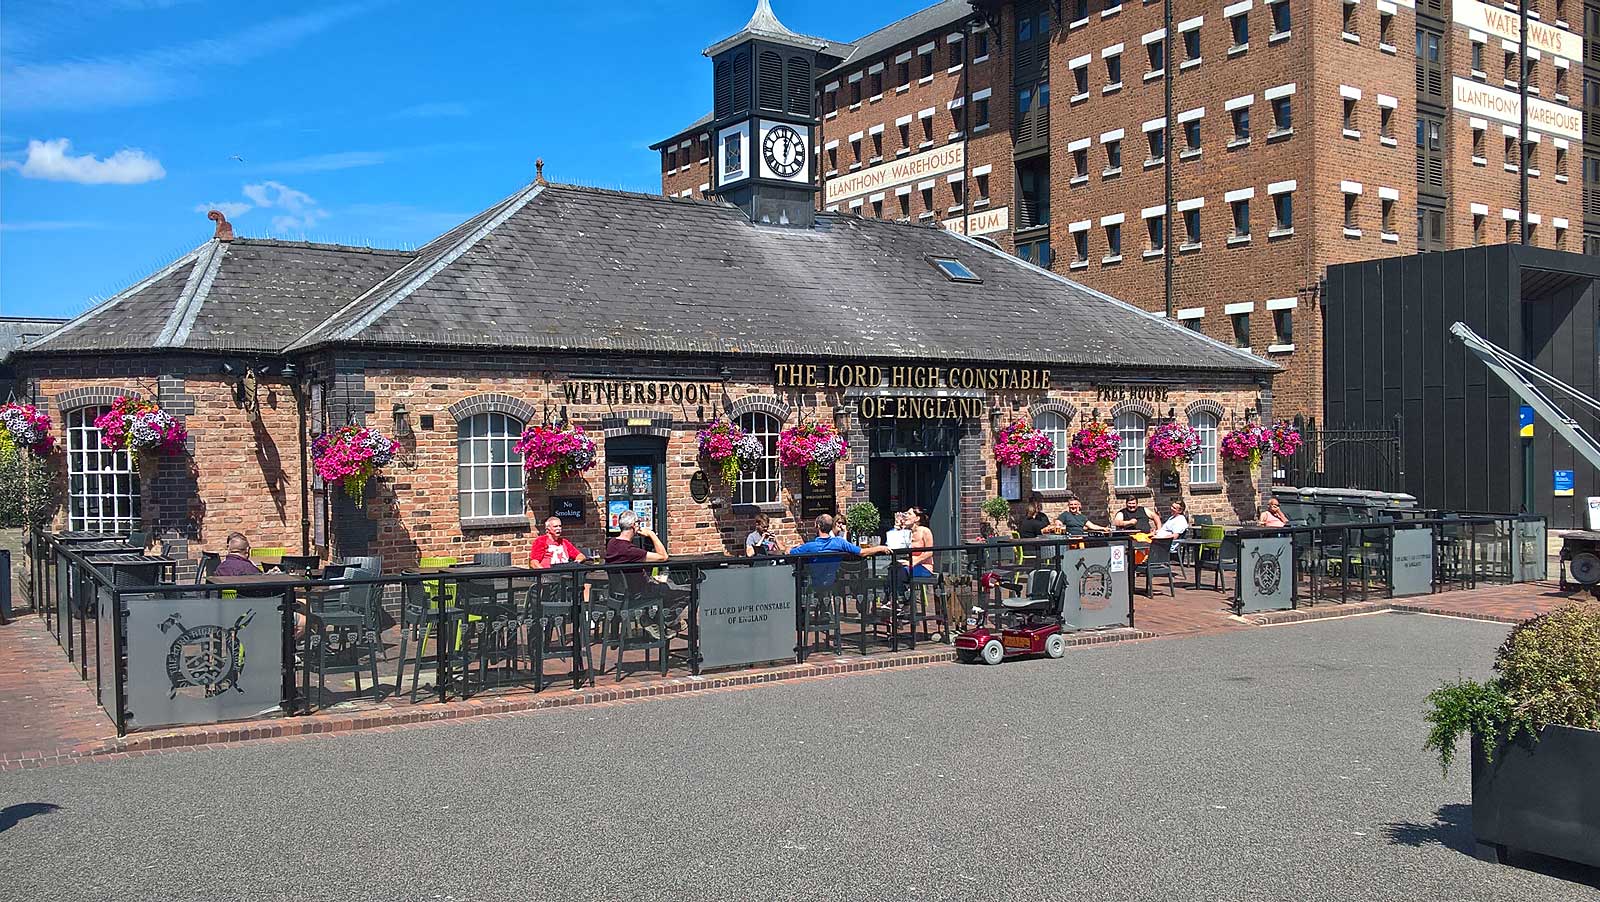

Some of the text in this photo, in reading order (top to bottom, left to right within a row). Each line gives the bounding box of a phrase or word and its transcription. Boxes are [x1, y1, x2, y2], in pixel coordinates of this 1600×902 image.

[1484, 8, 1562, 50] WATEWAYS
[1457, 85, 1519, 116] LLANTHONY
[829, 148, 962, 198] LLANTHONY WAREHOUSE
[949, 213, 999, 233] USEUM
[775, 364, 1051, 390] THE LORD HIGH CONSTABLE
[562, 382, 711, 405] WETHERSPOON
[1097, 384, 1169, 403] FREE HOUSE
[862, 397, 984, 420] OF ENGLAND
[555, 509, 581, 518] Smoking
[719, 606, 736, 615] LORD
